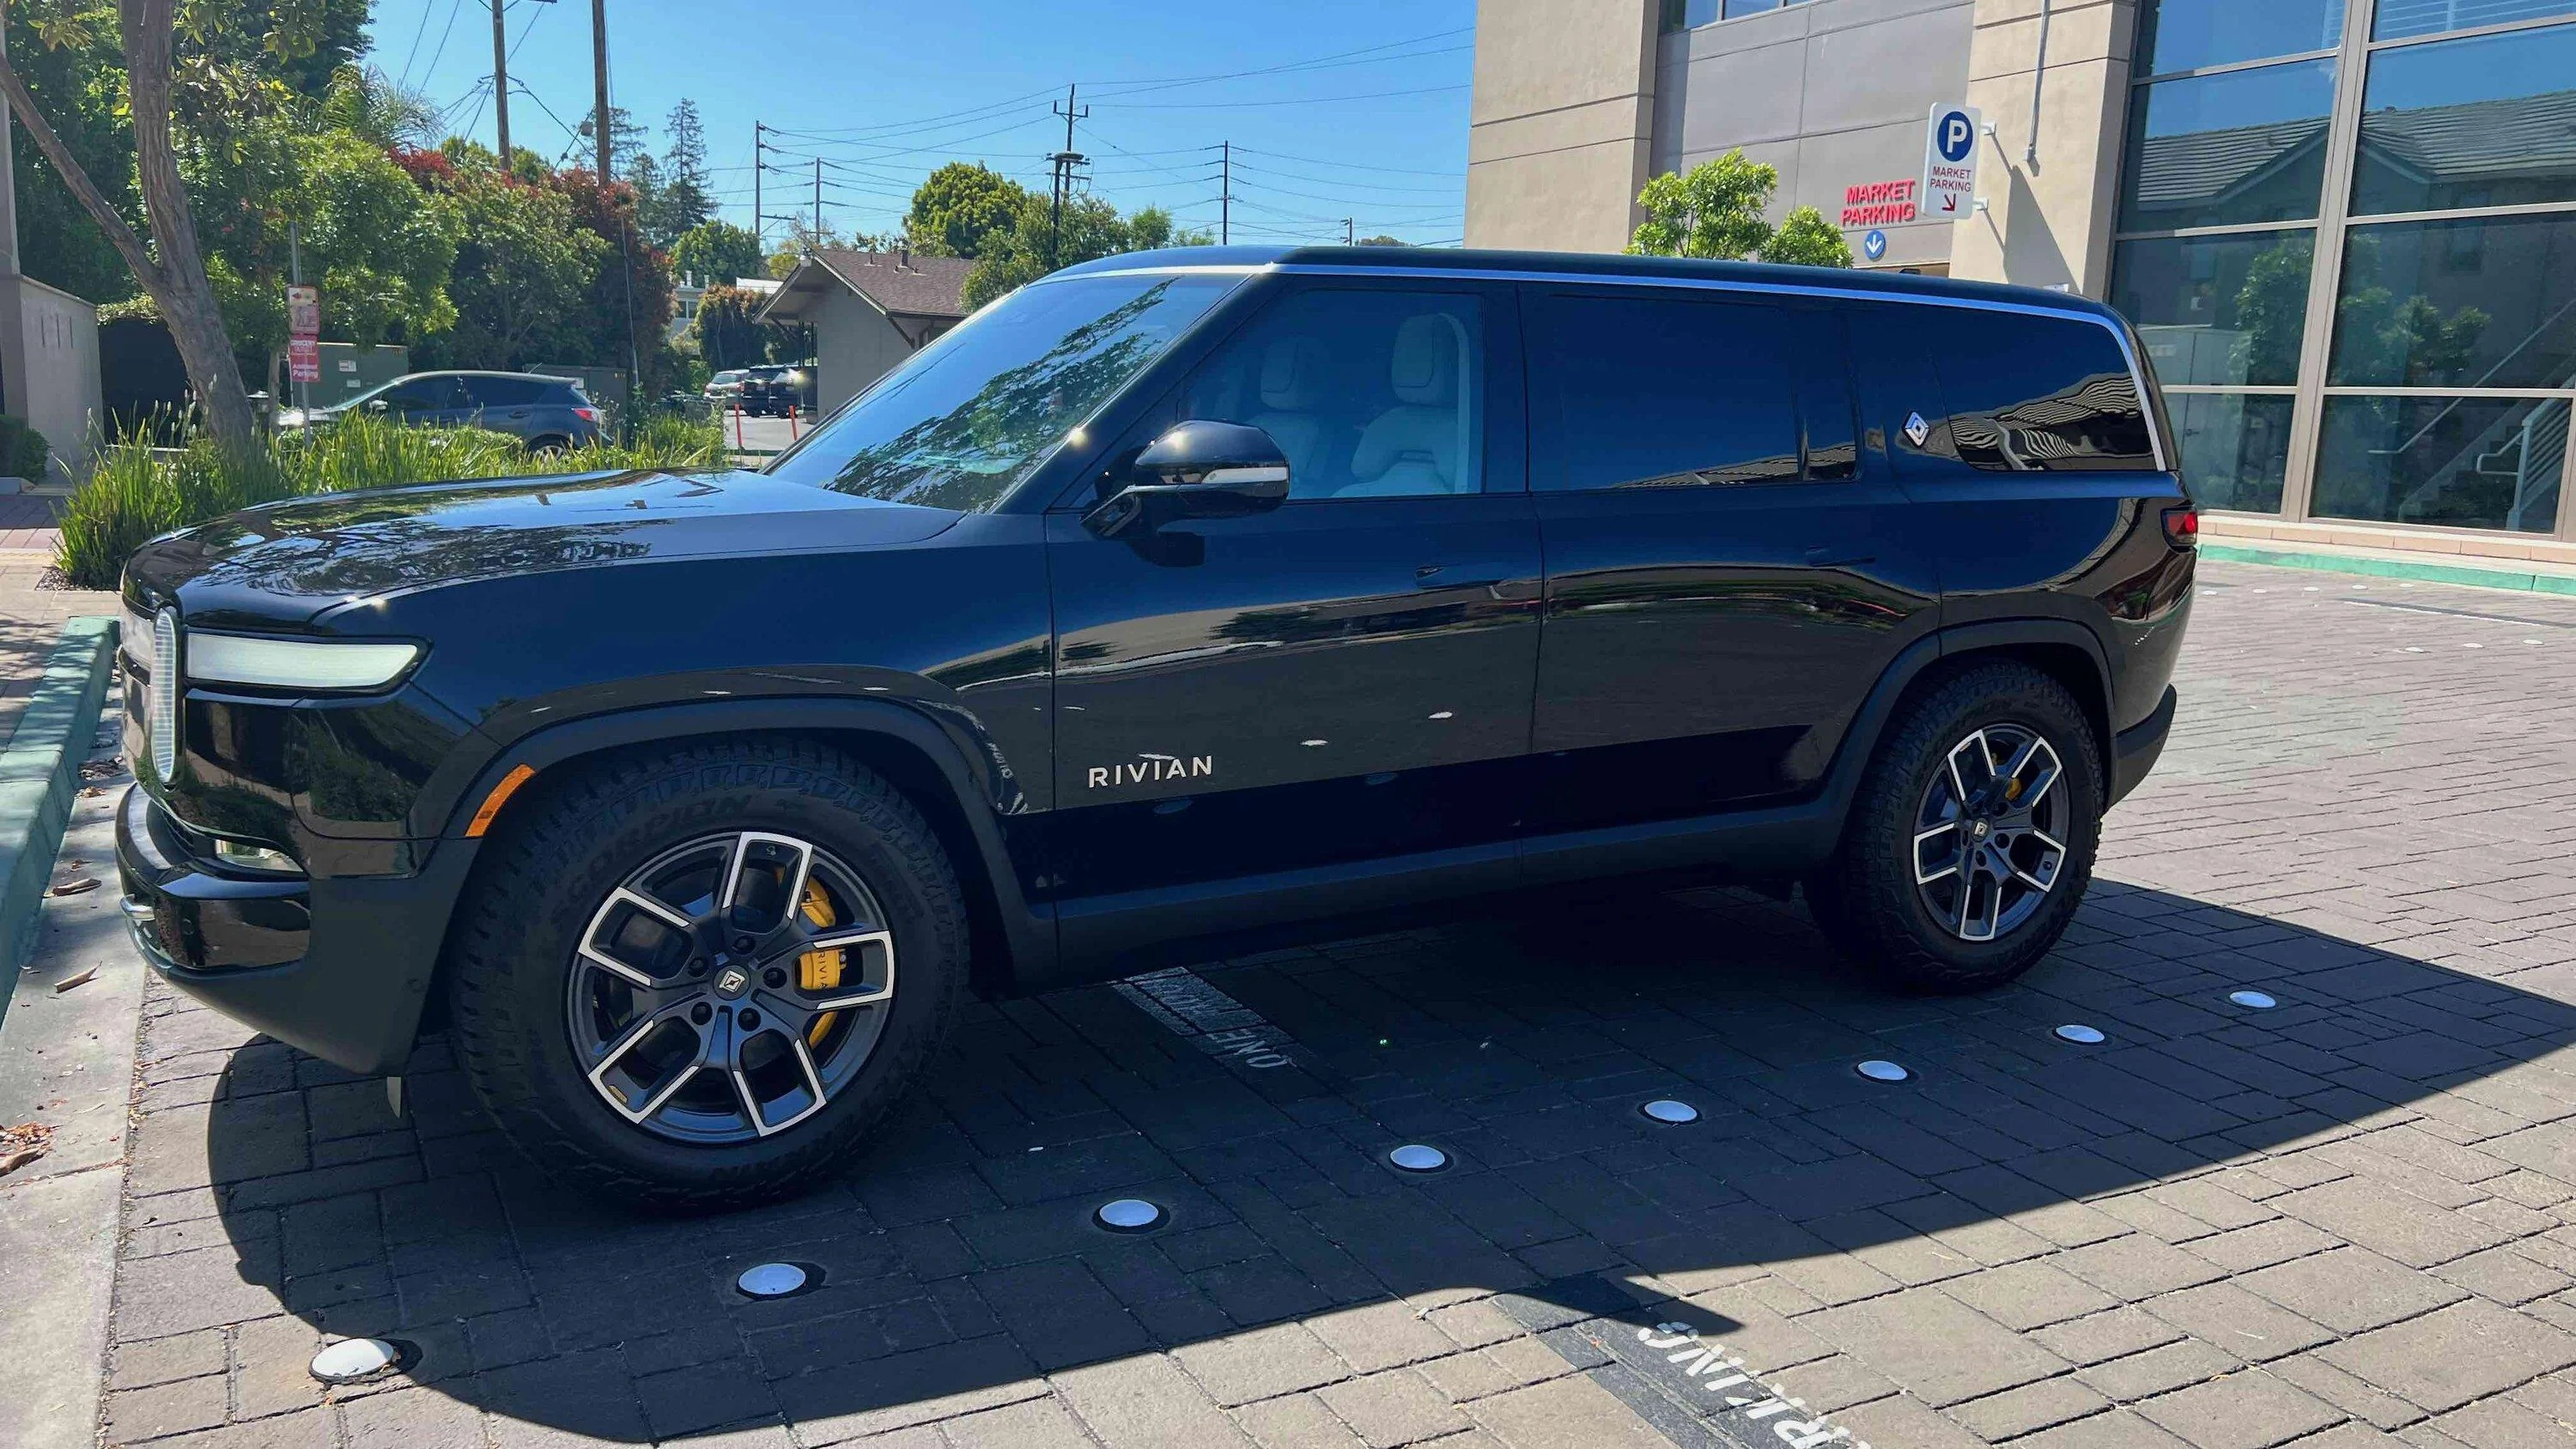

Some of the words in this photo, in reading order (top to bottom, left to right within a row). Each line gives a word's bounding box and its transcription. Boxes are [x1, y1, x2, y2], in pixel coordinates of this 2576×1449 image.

[1947, 119, 1967, 153] P
[1932, 166, 1971, 179] MARKET
[1846, 179, 1915, 203] MARKET
[1929, 179, 1971, 192] PARKING
[1840, 202, 1915, 227] PARKING
[1089, 755, 1212, 788] RIVIAN
